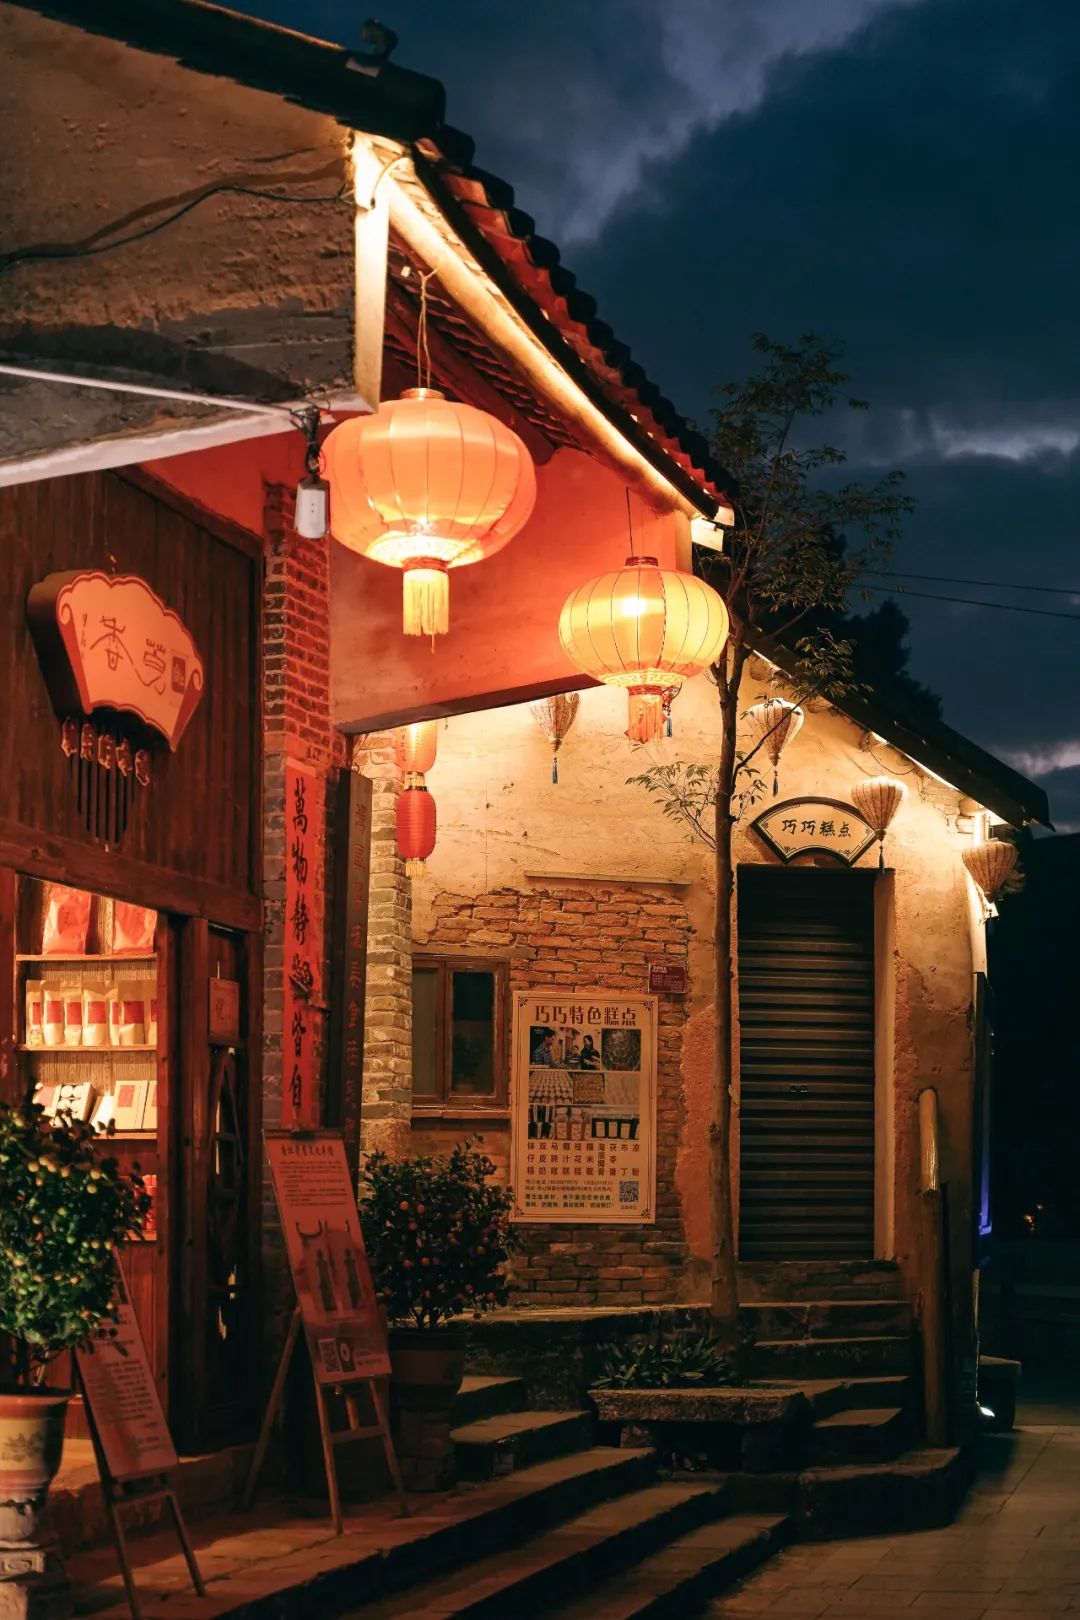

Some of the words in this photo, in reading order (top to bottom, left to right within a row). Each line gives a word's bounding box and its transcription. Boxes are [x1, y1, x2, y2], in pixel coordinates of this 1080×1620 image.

[781, 819, 851, 838] 巧巧糕点
[535, 1005, 637, 1026] 巧巧特色糕点
